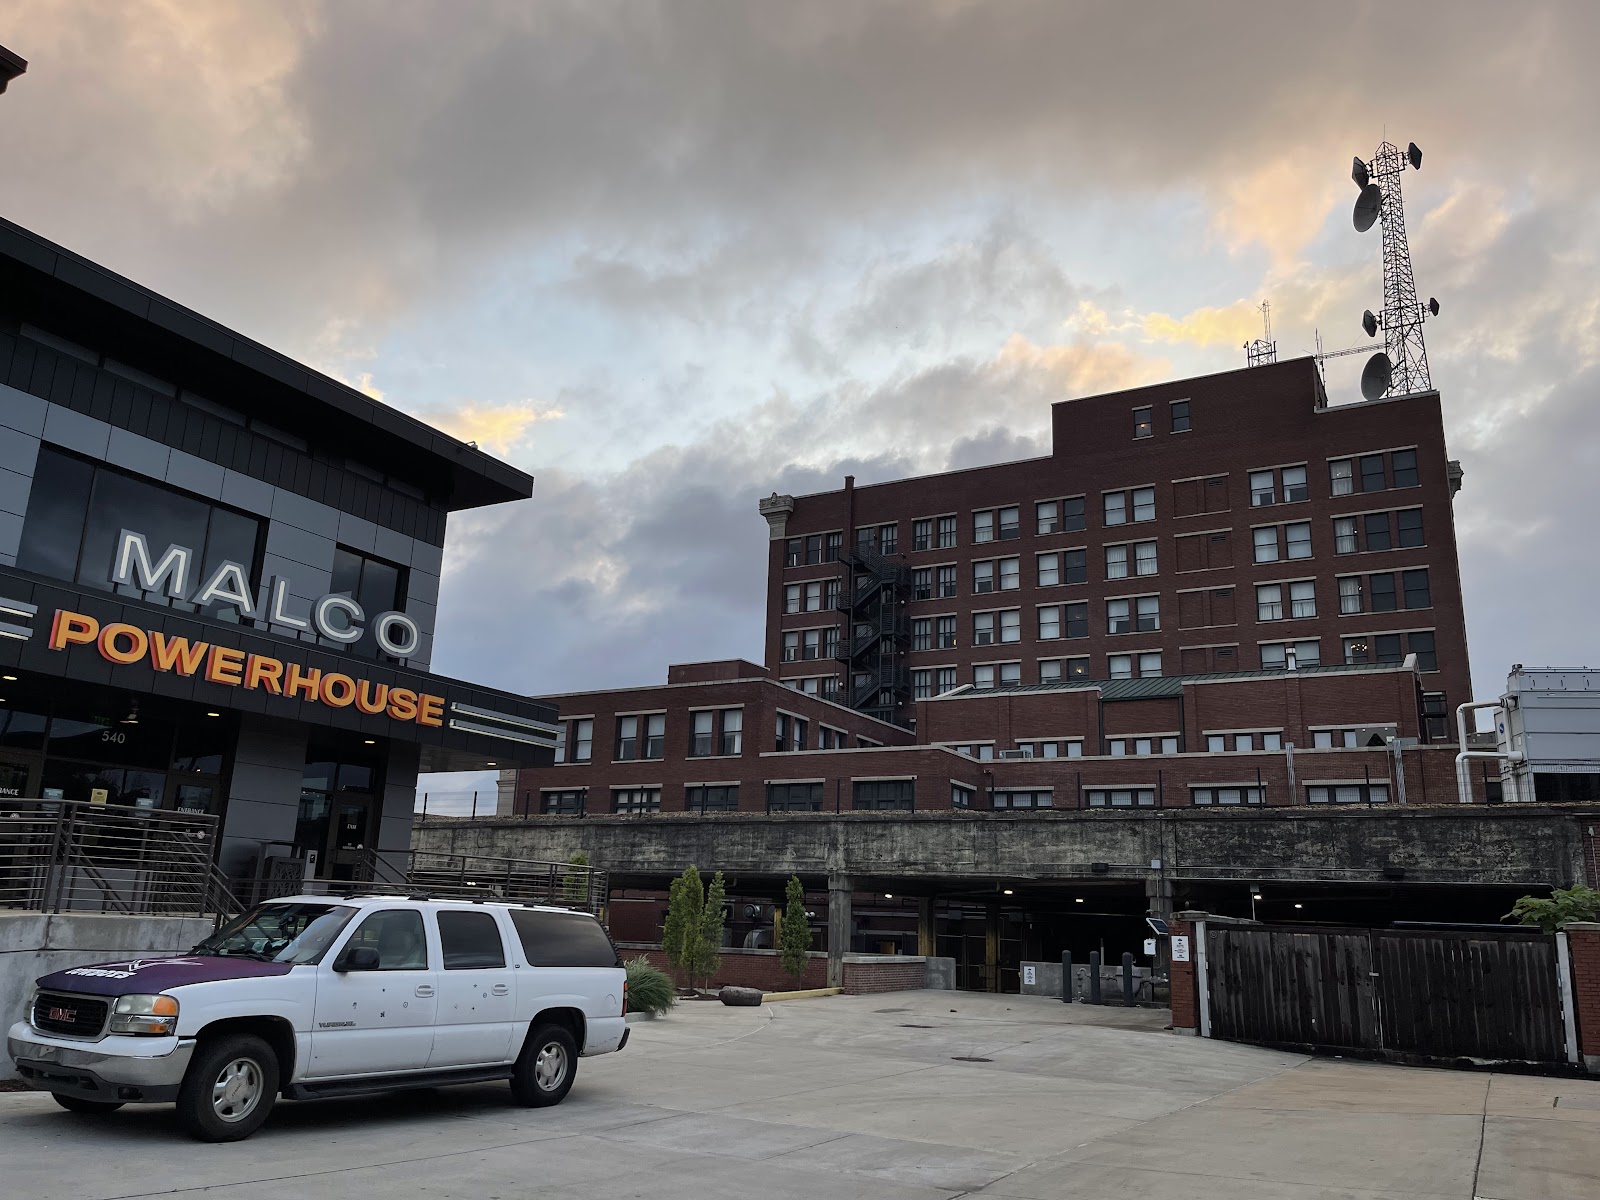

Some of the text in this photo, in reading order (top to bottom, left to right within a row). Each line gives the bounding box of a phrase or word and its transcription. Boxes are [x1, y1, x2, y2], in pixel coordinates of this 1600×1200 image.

[109, 528, 422, 659] MALCO
[48, 608, 446, 728] POWERHOUSE
[101, 730, 126, 744] 540
[49, 1007, 78, 1023] GMC
